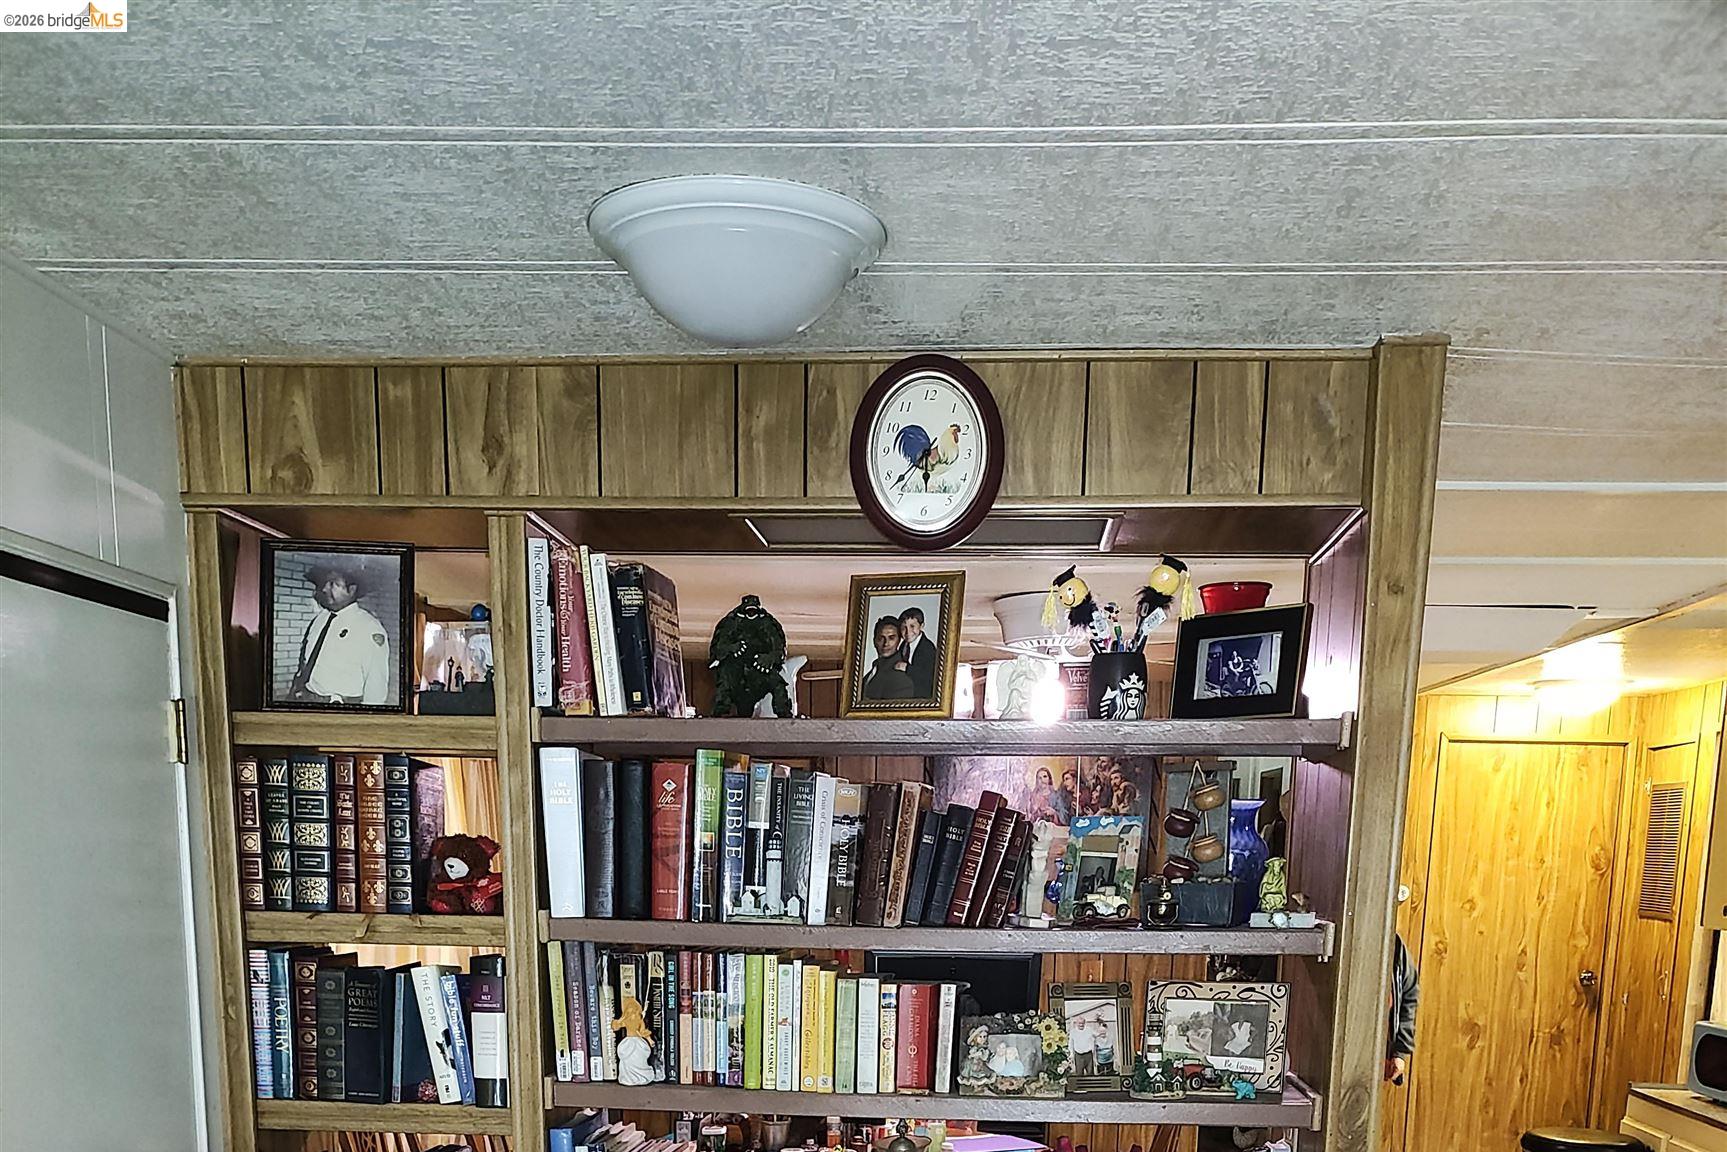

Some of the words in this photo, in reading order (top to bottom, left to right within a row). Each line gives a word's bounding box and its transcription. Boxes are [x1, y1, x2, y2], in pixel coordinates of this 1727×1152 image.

[923, 390, 938, 400] 12
[899, 402, 912, 412] 11
[951, 403, 957, 413] 1
[886, 423, 899, 434] 10
[962, 425, 969, 435] 2
[883, 446, 890, 457] 9
[964, 450, 971, 459] 3
[885, 470, 892, 480] 8
[961, 474, 968, 483] 4
[897, 493, 904, 503] 7
[945, 496, 952, 506] 5
[920, 505, 927, 516] 6
[534, 545, 543, 560] The
[533, 563, 545, 598] Country
[558, 557, 568, 609] Emotions
[535, 600, 545, 627] Doctor
[587, 608, 596, 631] HERB
[536, 630, 546, 674] Handbook
[590, 631, 600, 661] GARDEN
[561, 635, 572, 672] Health
[1068, 670, 1088, 683] Velve
[657, 791, 676, 805] life
[820, 790, 829, 810] Crisis
[820, 811, 828, 819] of
[725, 788, 743, 859] BIBLE
[839, 819, 851, 853] HOLY
[836, 855, 848, 887] BIBLE
[347, 988, 377, 998] GREAT
[420, 972, 430, 991] THE
[425, 996, 438, 1028] STORY
[572, 981, 581, 1008] Season
[348, 998, 377, 1007] POEMS
[574, 1011, 581, 1020] of
[274, 997, 288, 1053] POETRY
[767, 1008, 775, 1040] FARMER'S
[453, 1025, 465, 1048] stuff
[574, 1022, 582, 1051] Darkne
[767, 1041, 775, 1074] ALMANAC
[1237, 1061, 1256, 1072] Happy
